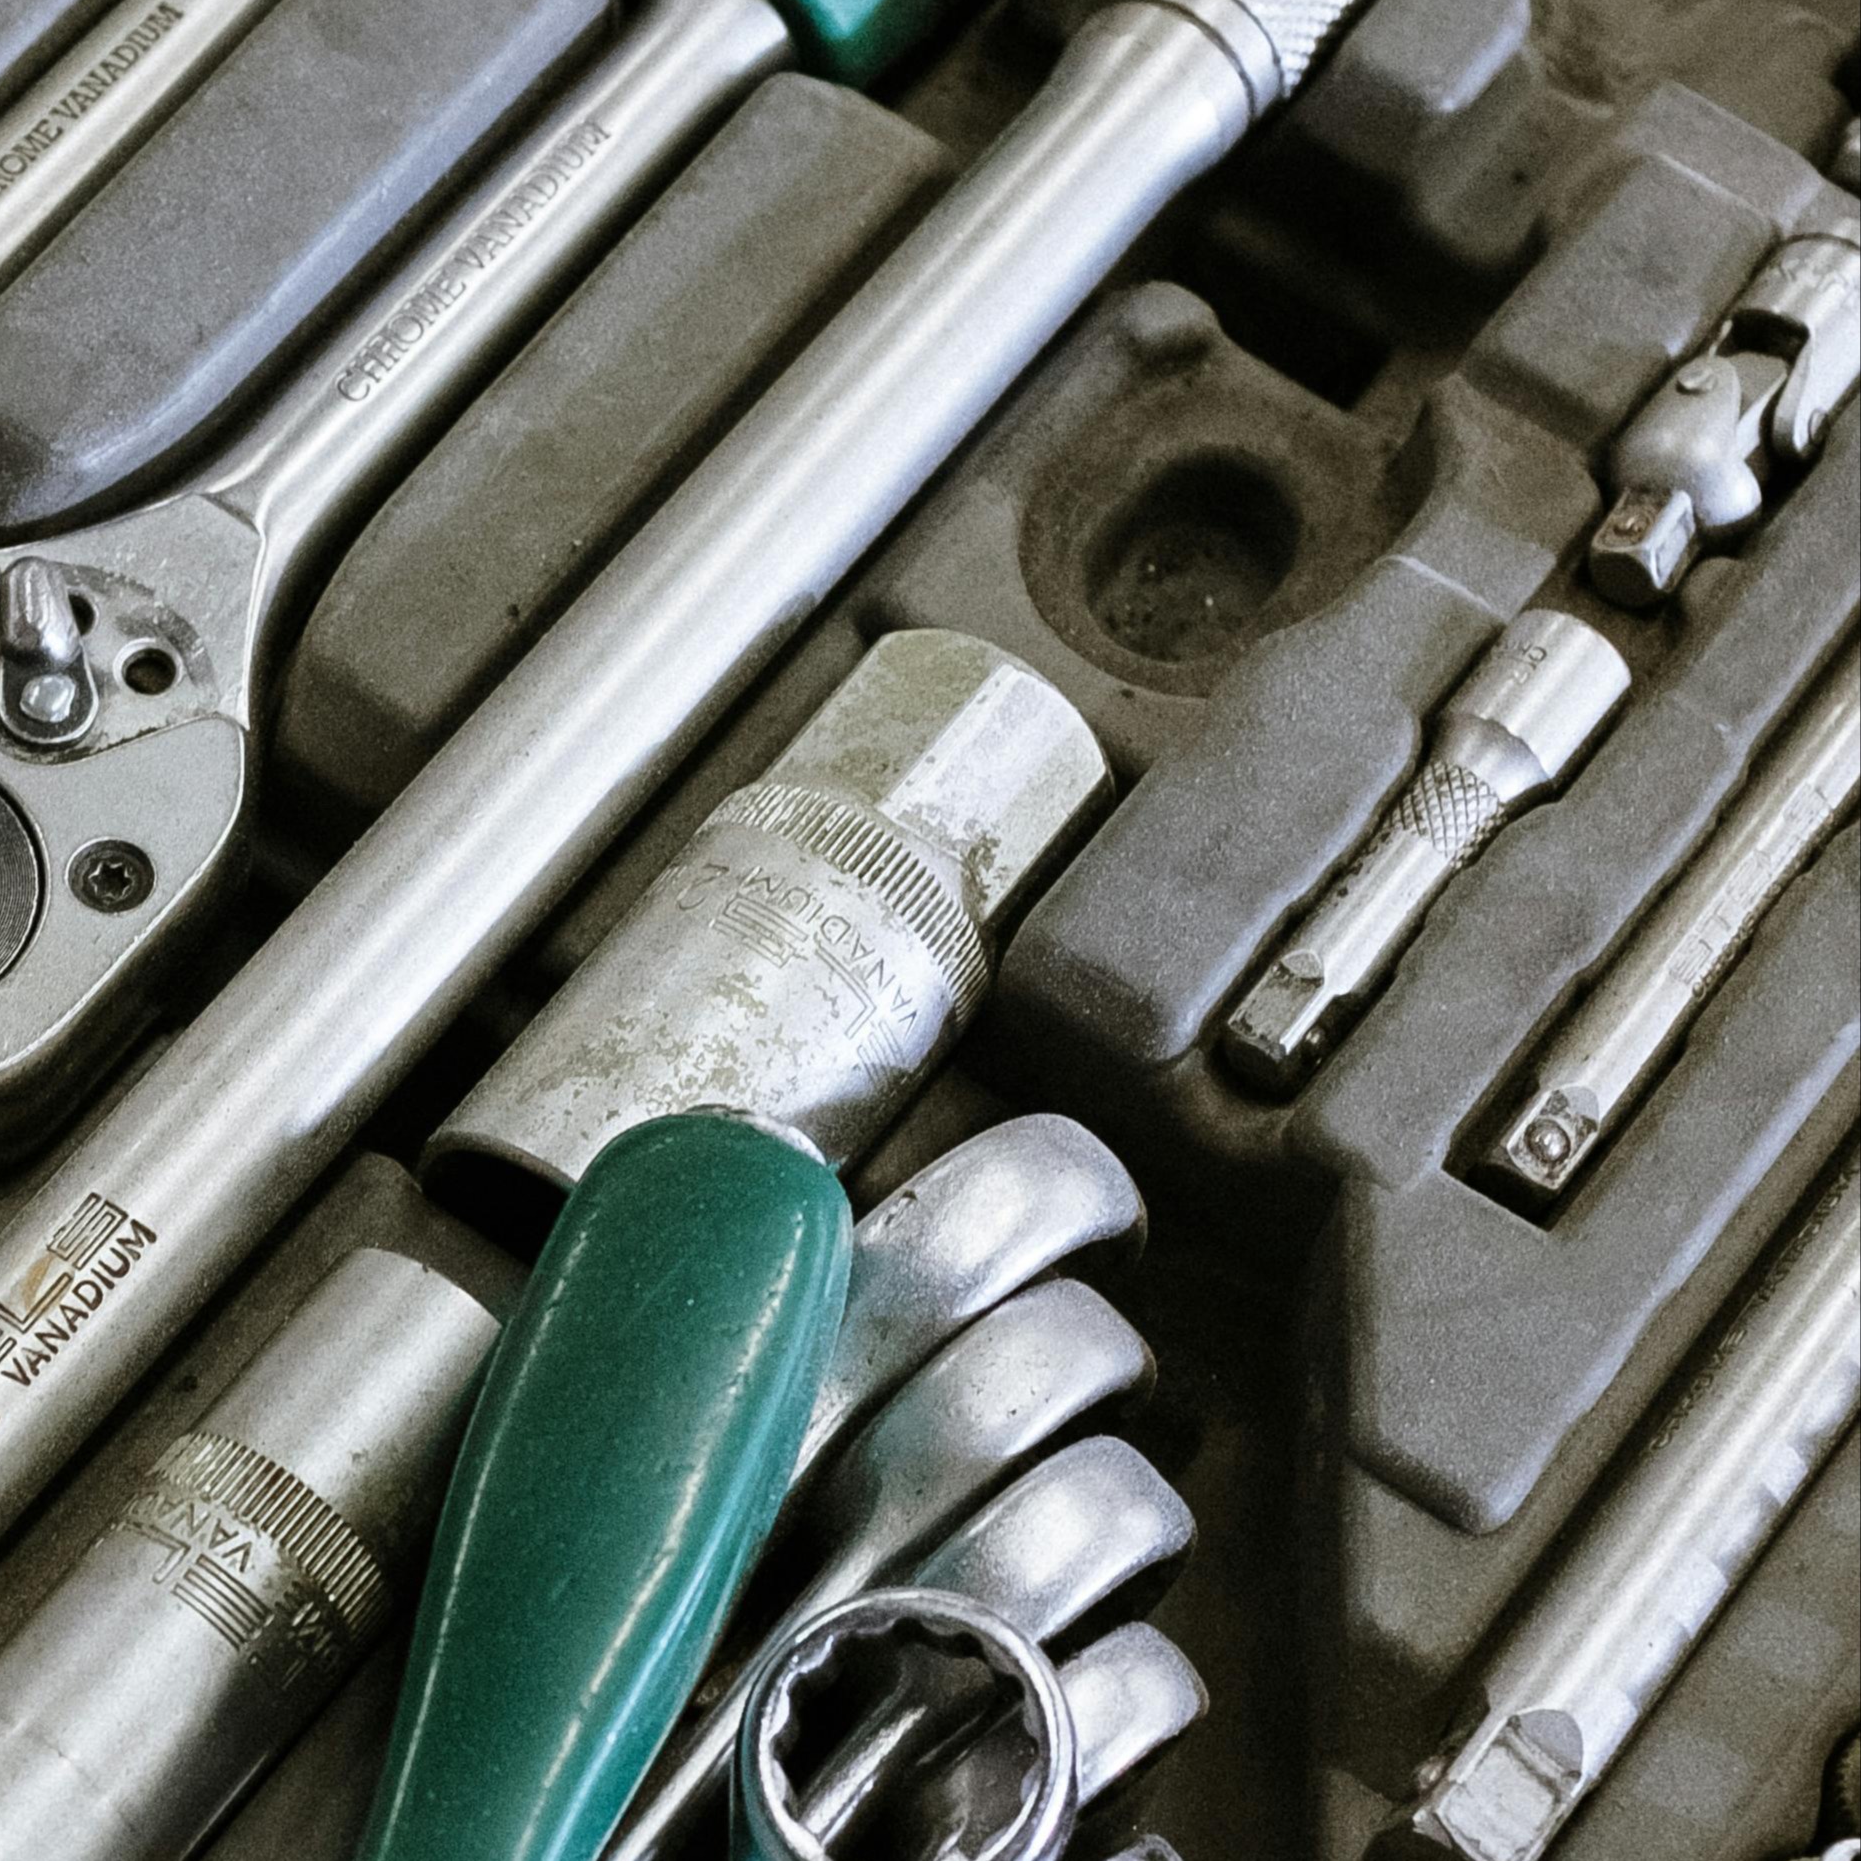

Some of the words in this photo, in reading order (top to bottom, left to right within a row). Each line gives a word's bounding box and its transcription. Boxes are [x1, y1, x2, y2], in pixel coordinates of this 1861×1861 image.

[49, 0, 185, 121] VANADIUM
[337, 273, 468, 402] CHROME
[451, 119, 611, 271] VANADIUM
[736, 864, 919, 1038] VANADIUM
[0, 1217, 158, 1387] VANADIUM
